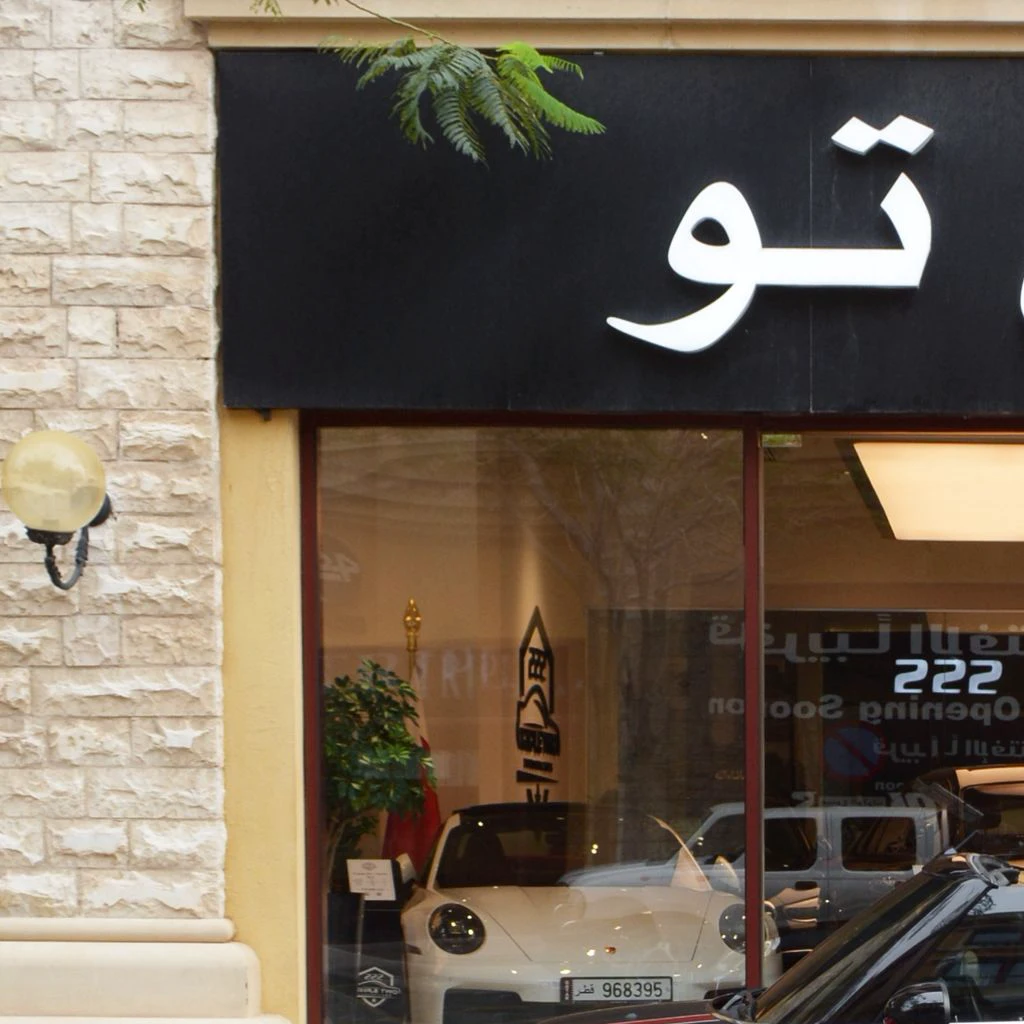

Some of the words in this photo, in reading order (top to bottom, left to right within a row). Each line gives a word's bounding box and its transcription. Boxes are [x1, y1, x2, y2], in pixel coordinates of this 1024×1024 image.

[605, 113, 936, 353] تو
[893, 658, 1003, 694] 222
[602, 982, 663, 998] 968395
